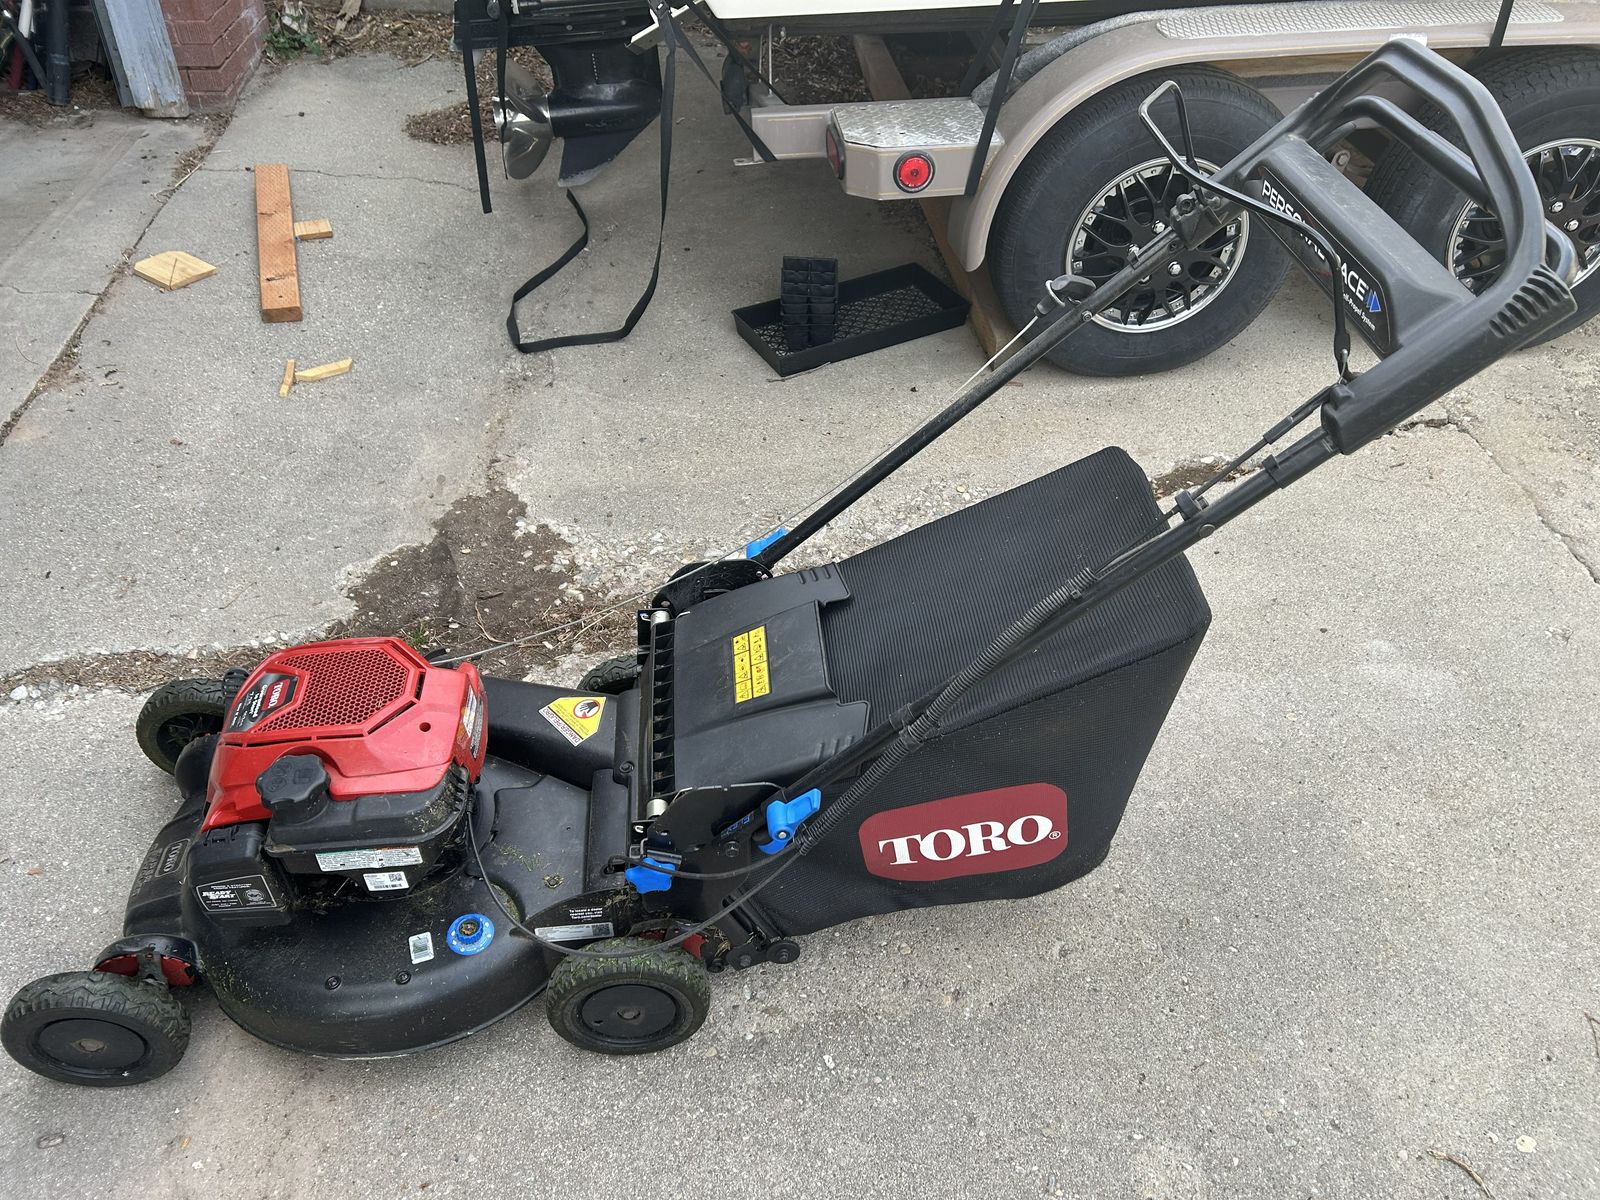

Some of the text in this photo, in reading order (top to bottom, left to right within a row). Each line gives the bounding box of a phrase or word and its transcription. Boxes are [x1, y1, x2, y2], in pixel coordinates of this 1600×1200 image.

[1341, 263, 1368, 301] ACE
[1361, 311, 1376, 331] System
[163, 842, 183, 872] TORO
